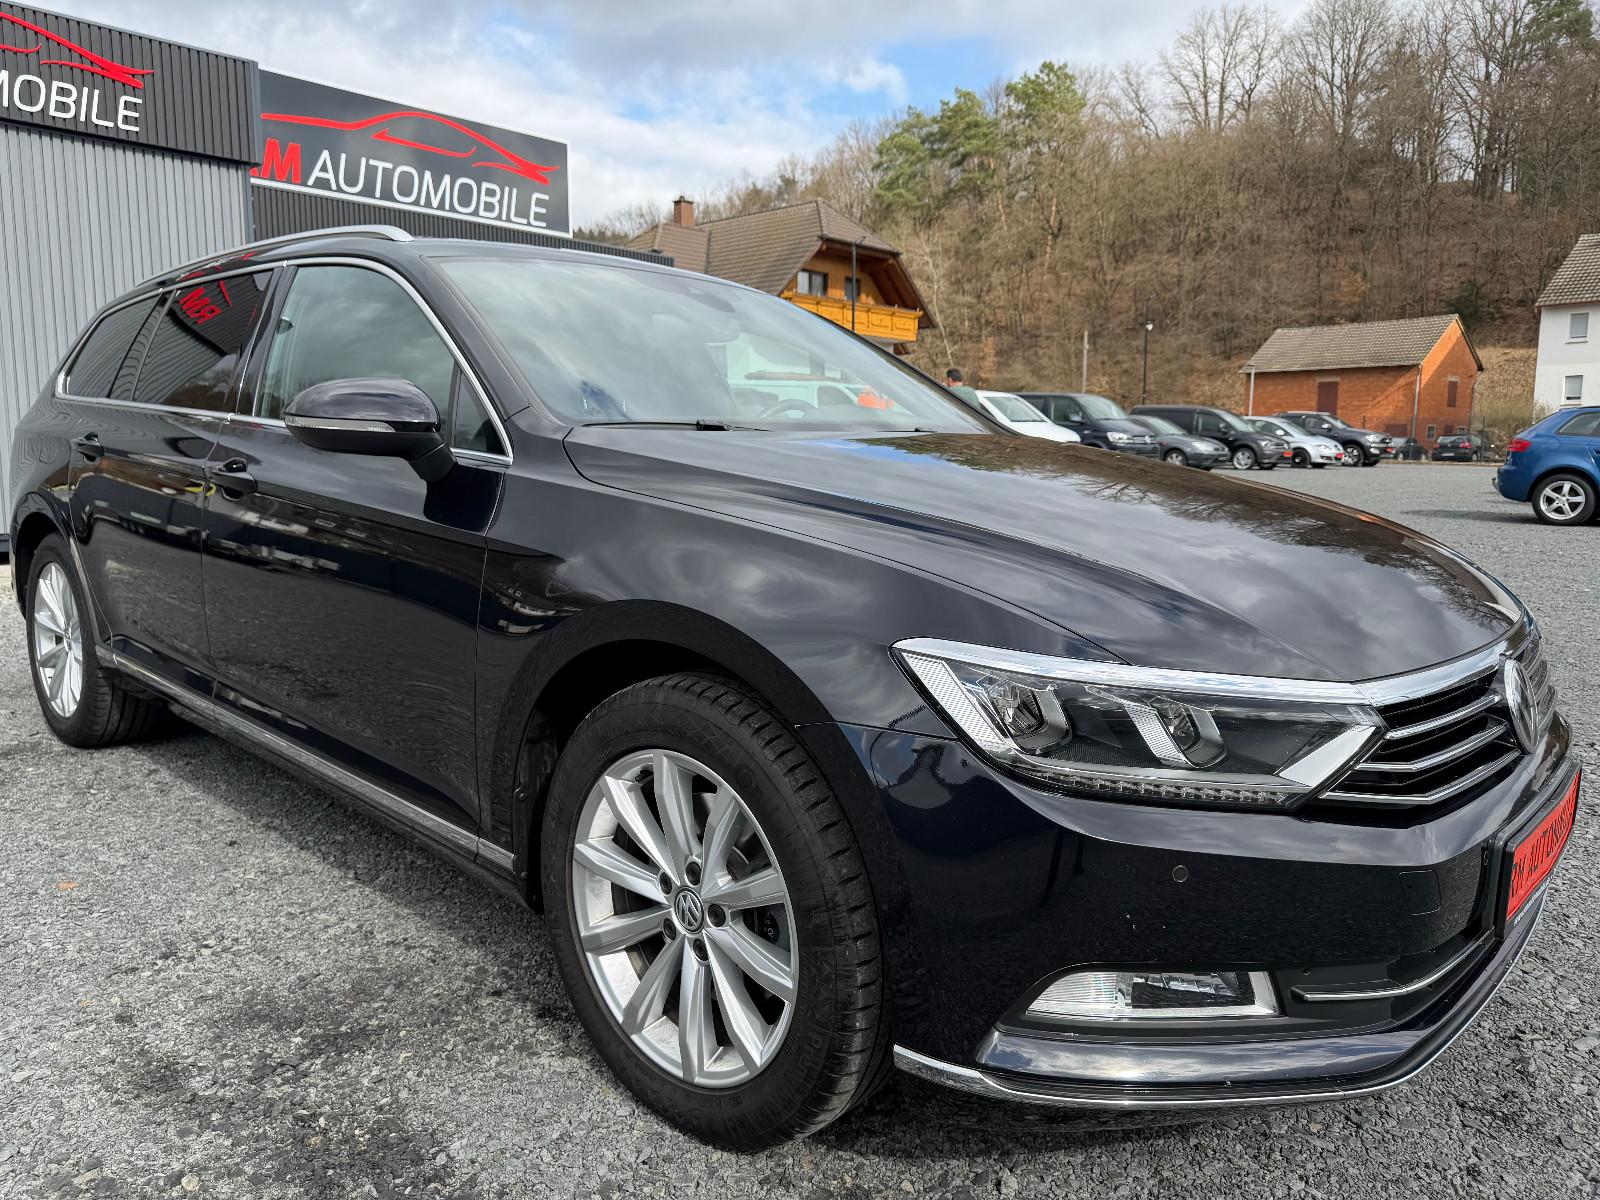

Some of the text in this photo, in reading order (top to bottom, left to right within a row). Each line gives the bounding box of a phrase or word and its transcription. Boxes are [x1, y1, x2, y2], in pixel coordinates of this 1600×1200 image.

[0, 69, 143, 132] OBILE
[250, 137, 550, 228] M AUTOMOBILE
